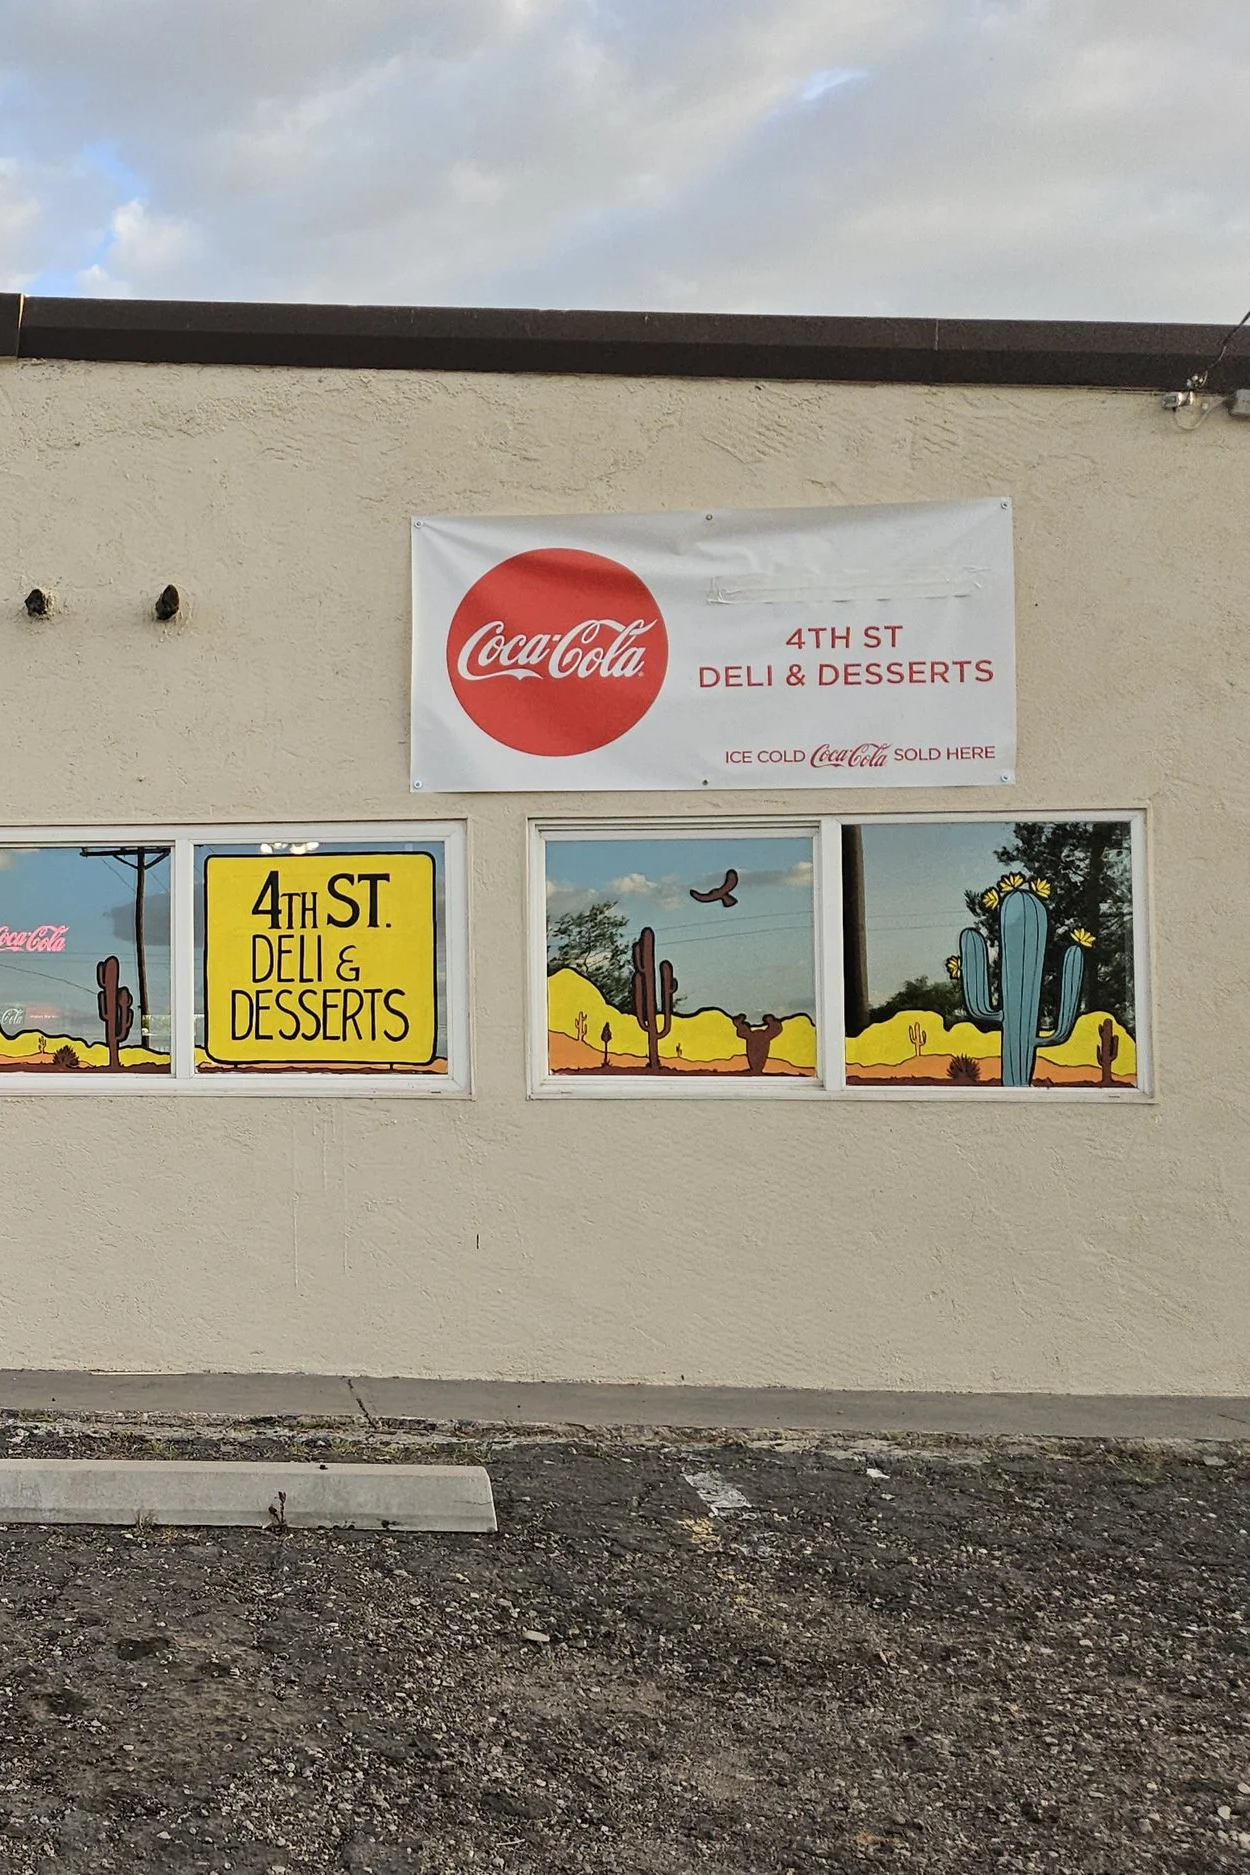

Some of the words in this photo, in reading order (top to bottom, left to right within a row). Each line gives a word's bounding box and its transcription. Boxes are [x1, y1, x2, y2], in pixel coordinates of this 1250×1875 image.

[457, 618, 659, 681] Coca-Cola
[786, 626, 851, 649] 4TH
[863, 625, 903, 648] ST
[698, 664, 773, 688] DELI
[785, 663, 805, 687] &
[818, 659, 994, 686] DESSERTS
[725, 750, 753, 764] ICE
[757, 750, 806, 763] COLD
[810, 742, 894, 768] Coca-Cola
[893, 747, 941, 762] SOLD
[946, 746, 996, 760] HERE
[251, 870, 318, 930] 4TH
[326, 873, 392, 929] ST.
[252, 934, 322, 983] DELI
[336, 944, 361, 982] &
[231, 988, 409, 1042] DESSERTS
